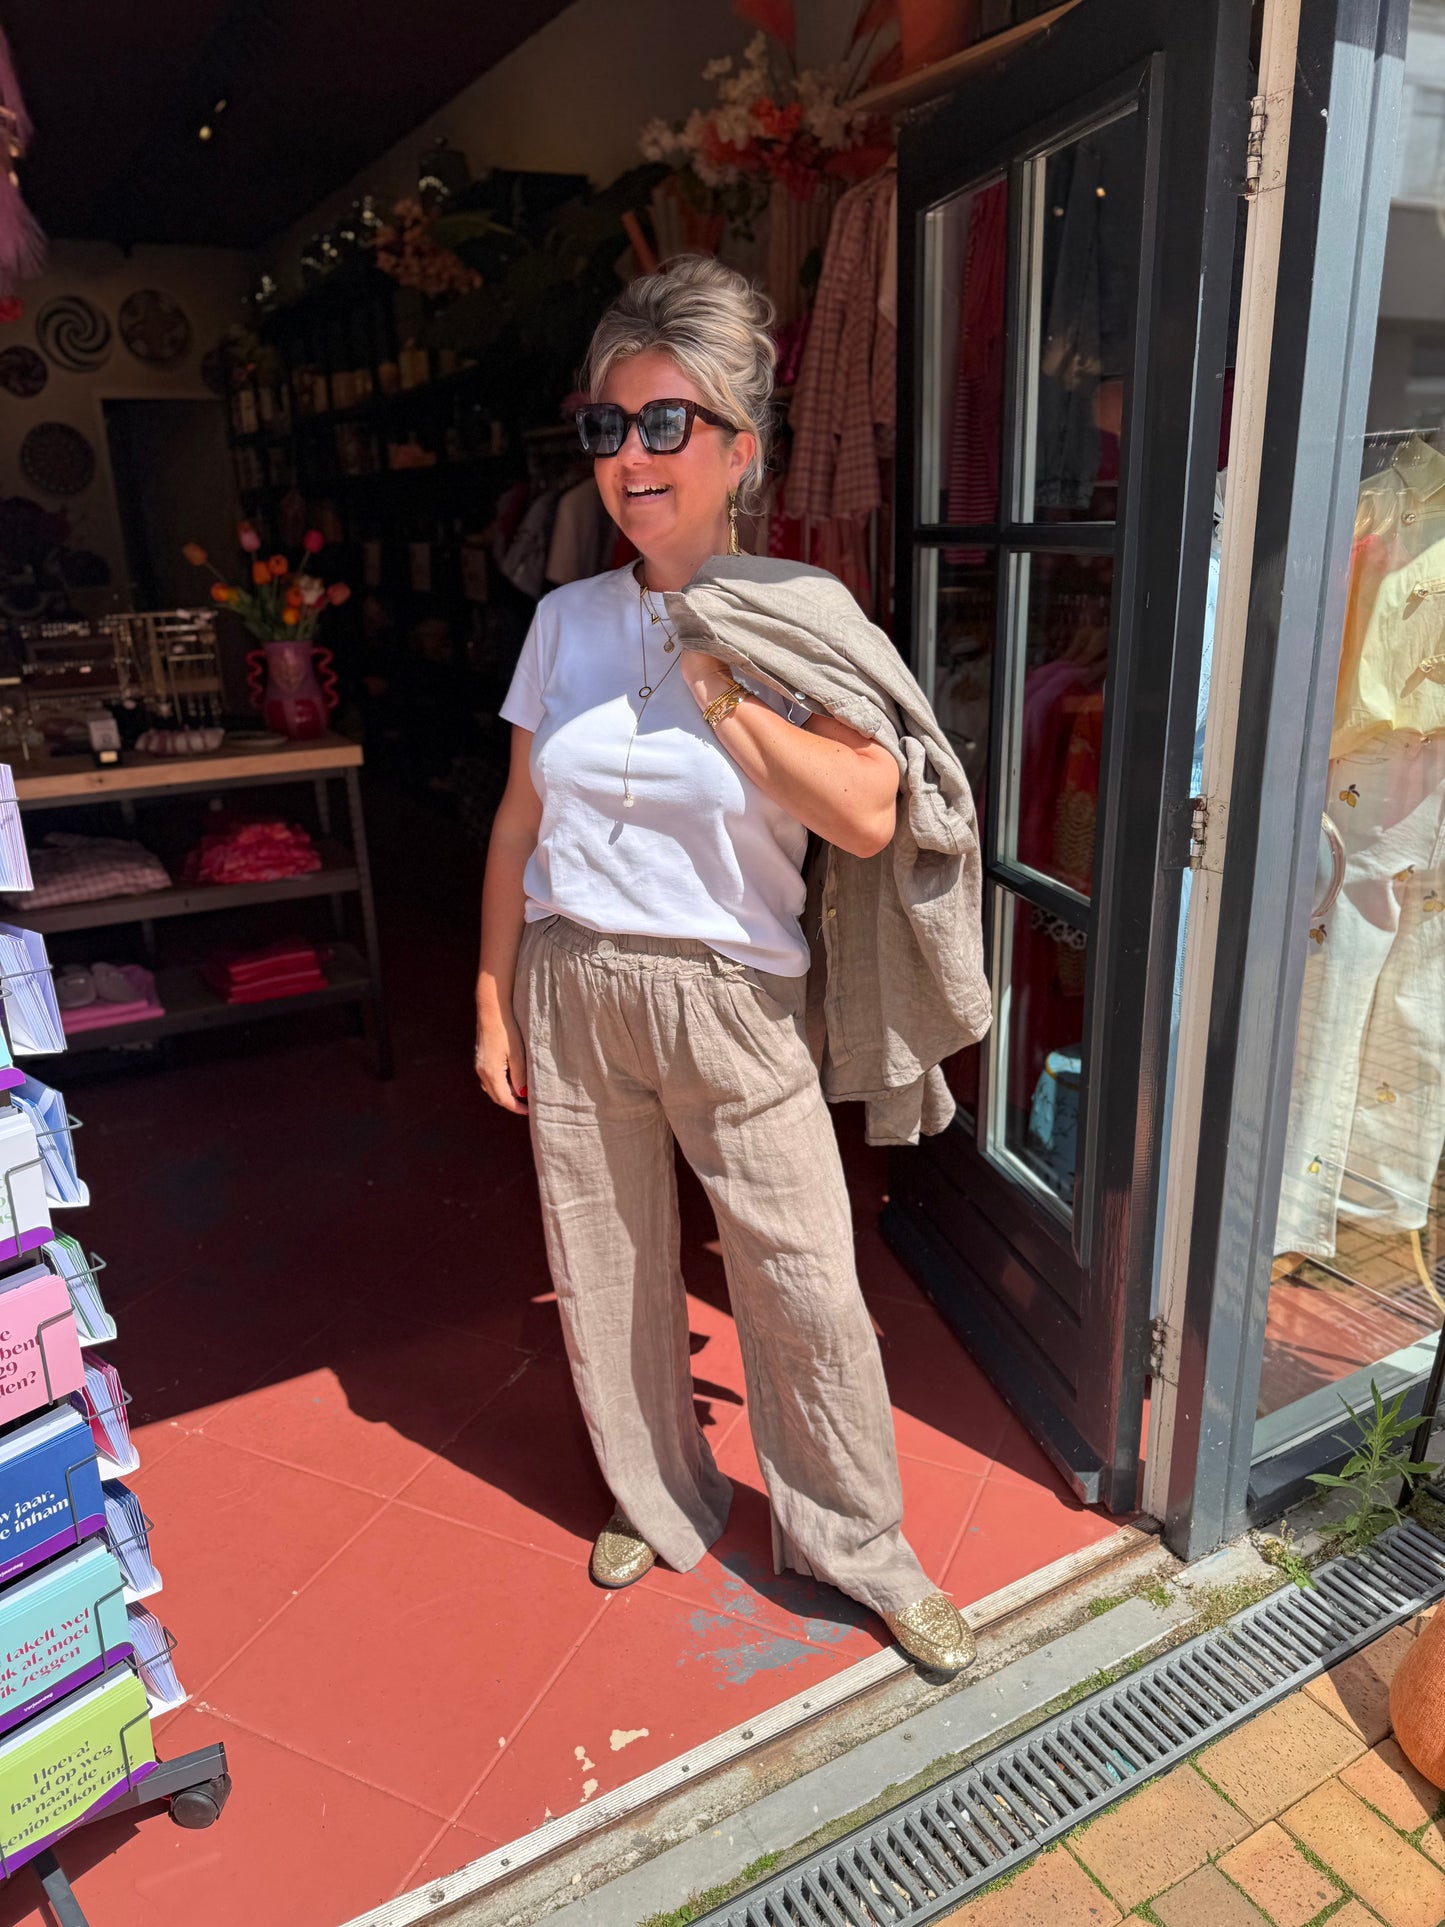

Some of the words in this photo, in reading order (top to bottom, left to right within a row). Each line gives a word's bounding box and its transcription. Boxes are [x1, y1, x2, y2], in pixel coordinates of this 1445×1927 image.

[0, 1528, 11, 1540] e
[14, 1498, 69, 1533] inham
[15, 1490, 55, 1519] jaar,
[6, 1627, 56, 1663] takelt
[61, 1607, 89, 1630] wel
[47, 1623, 89, 1656] moet
[10, 1780, 51, 1815] hard
[55, 1767, 77, 1786] op
[80, 1744, 113, 1769] weg
[33, 1740, 90, 1785] Hoera!
[35, 1783, 73, 1814] naar
[77, 1768, 97, 1786] de
